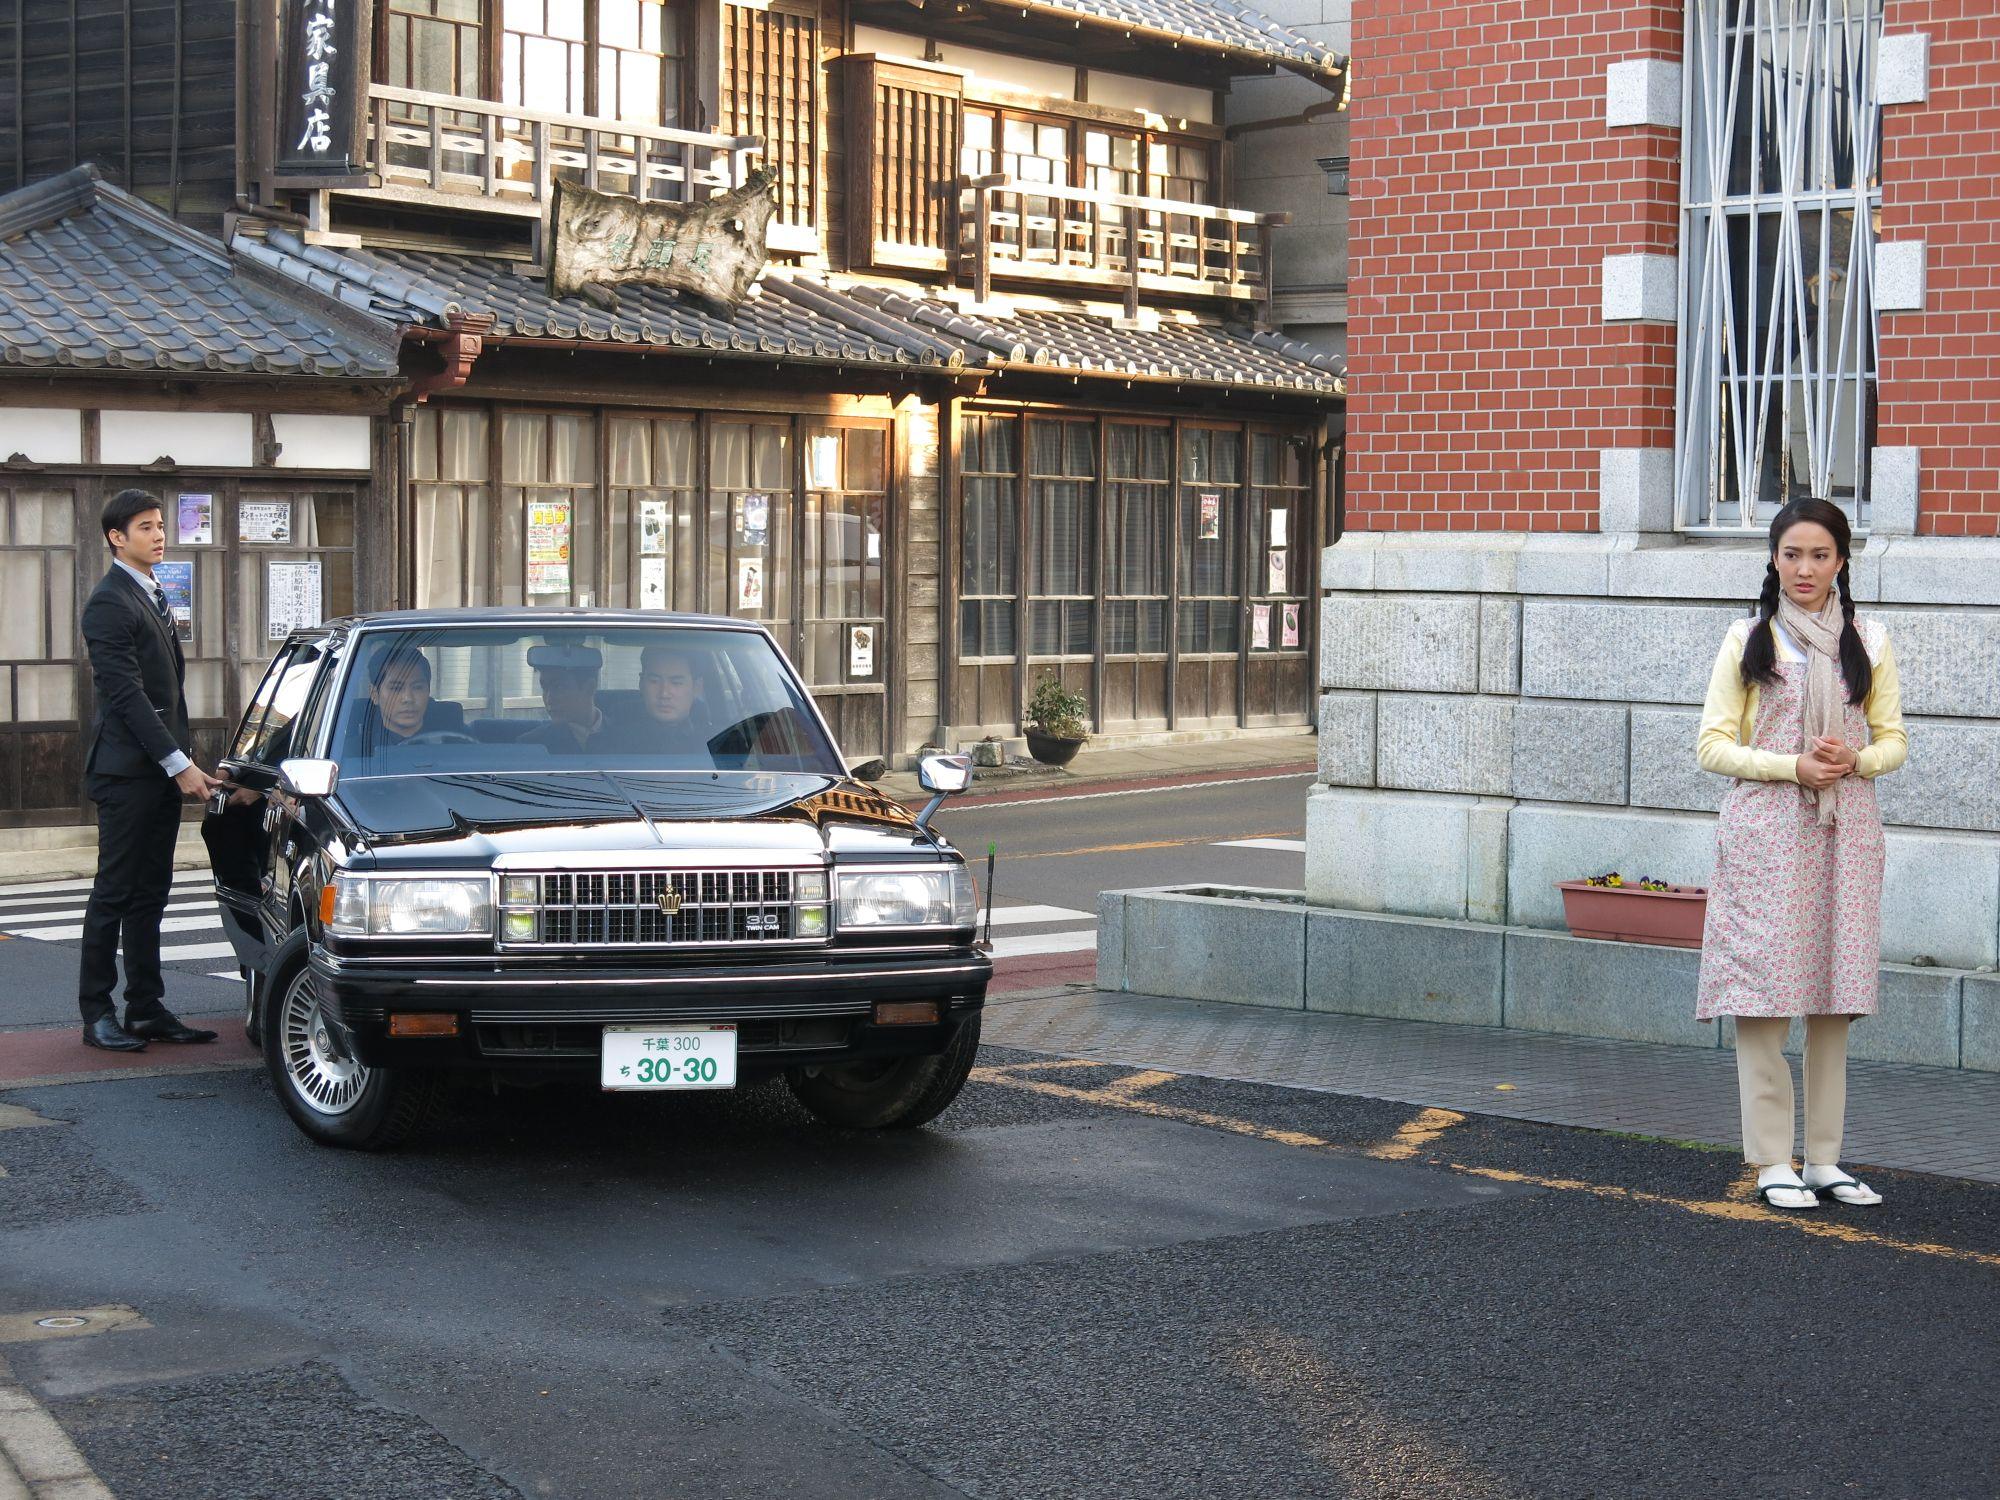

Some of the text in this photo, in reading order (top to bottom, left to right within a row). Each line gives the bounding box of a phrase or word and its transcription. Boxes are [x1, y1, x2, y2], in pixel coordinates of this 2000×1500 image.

[297, 0, 337, 151] 家具店
[746, 914, 778, 924] 3.0
[642, 1036, 701, 1051] 千葉 300
[618, 1057, 717, 1083] ち 30-30
